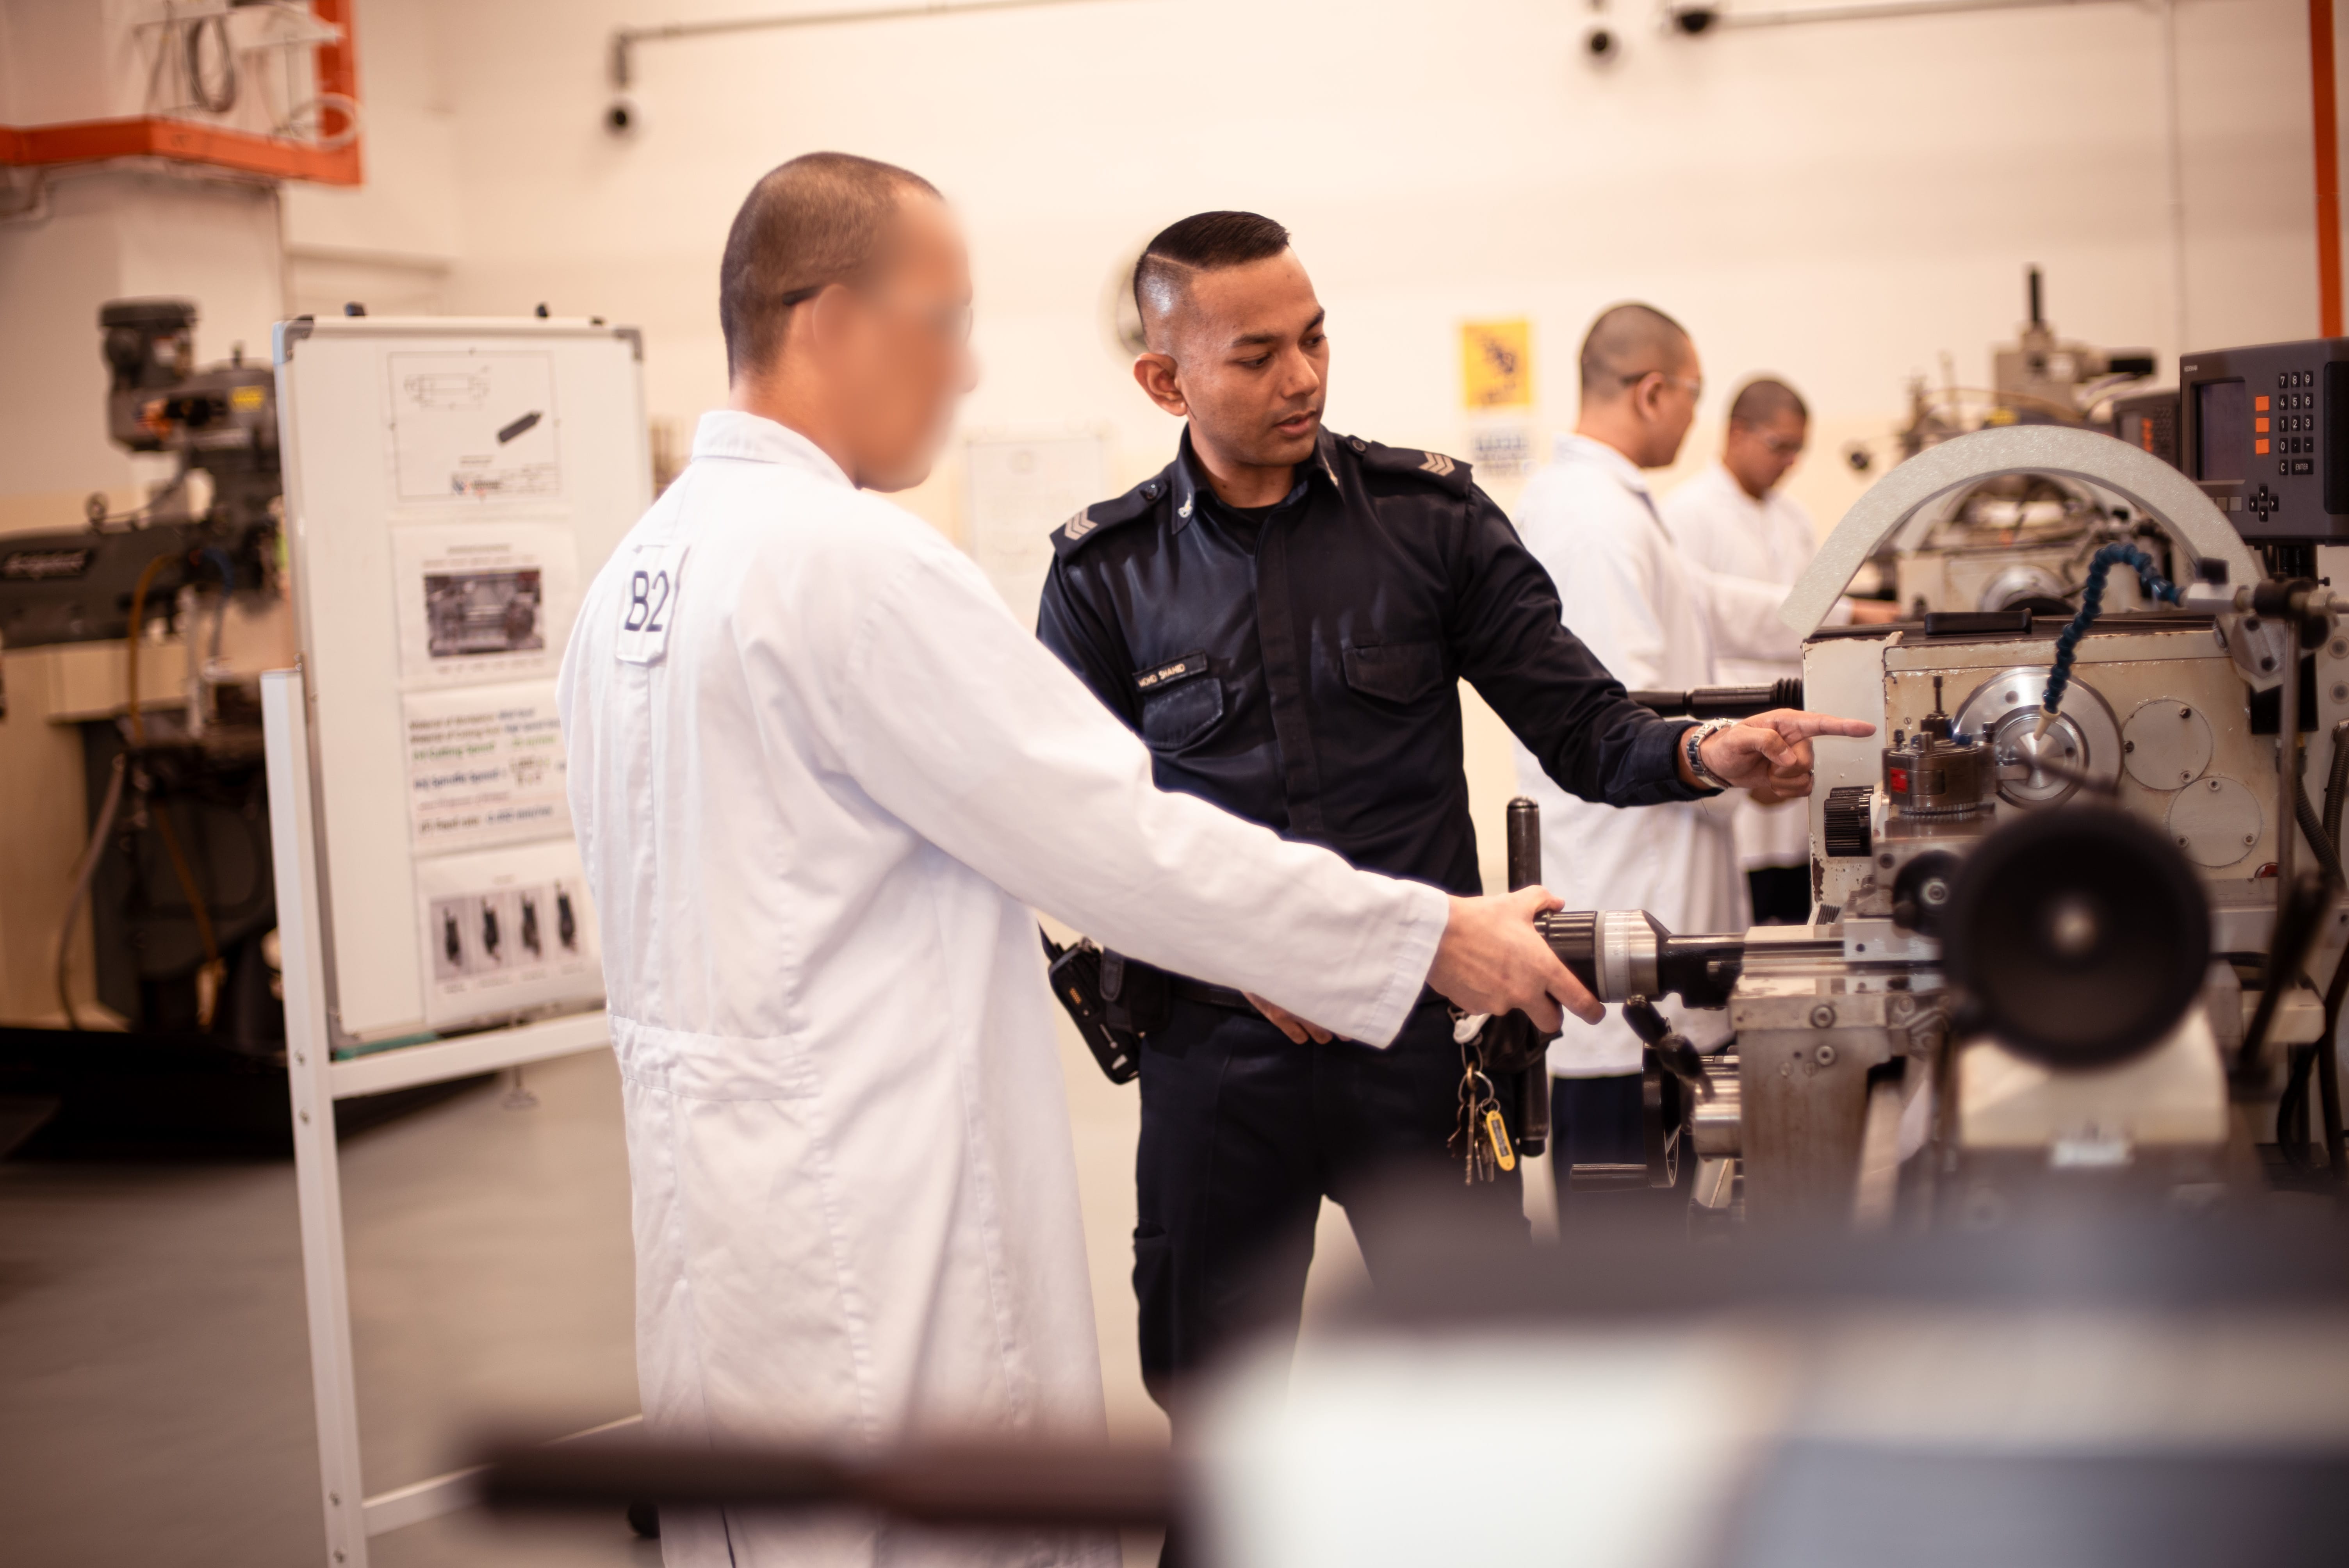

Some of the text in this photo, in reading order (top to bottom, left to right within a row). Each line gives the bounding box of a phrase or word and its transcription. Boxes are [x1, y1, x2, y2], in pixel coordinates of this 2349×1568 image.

[2280, 374, 2310, 386] 7 8 9
[2280, 396, 2310, 407] 4 5 6
[2281, 418, 2310, 428] 1 2 3
[2280, 442, 2285, 450] 0
[2281, 463, 2285, 471] C
[624, 570, 669, 632] B2
[1138, 674, 1157, 687] MOHD
